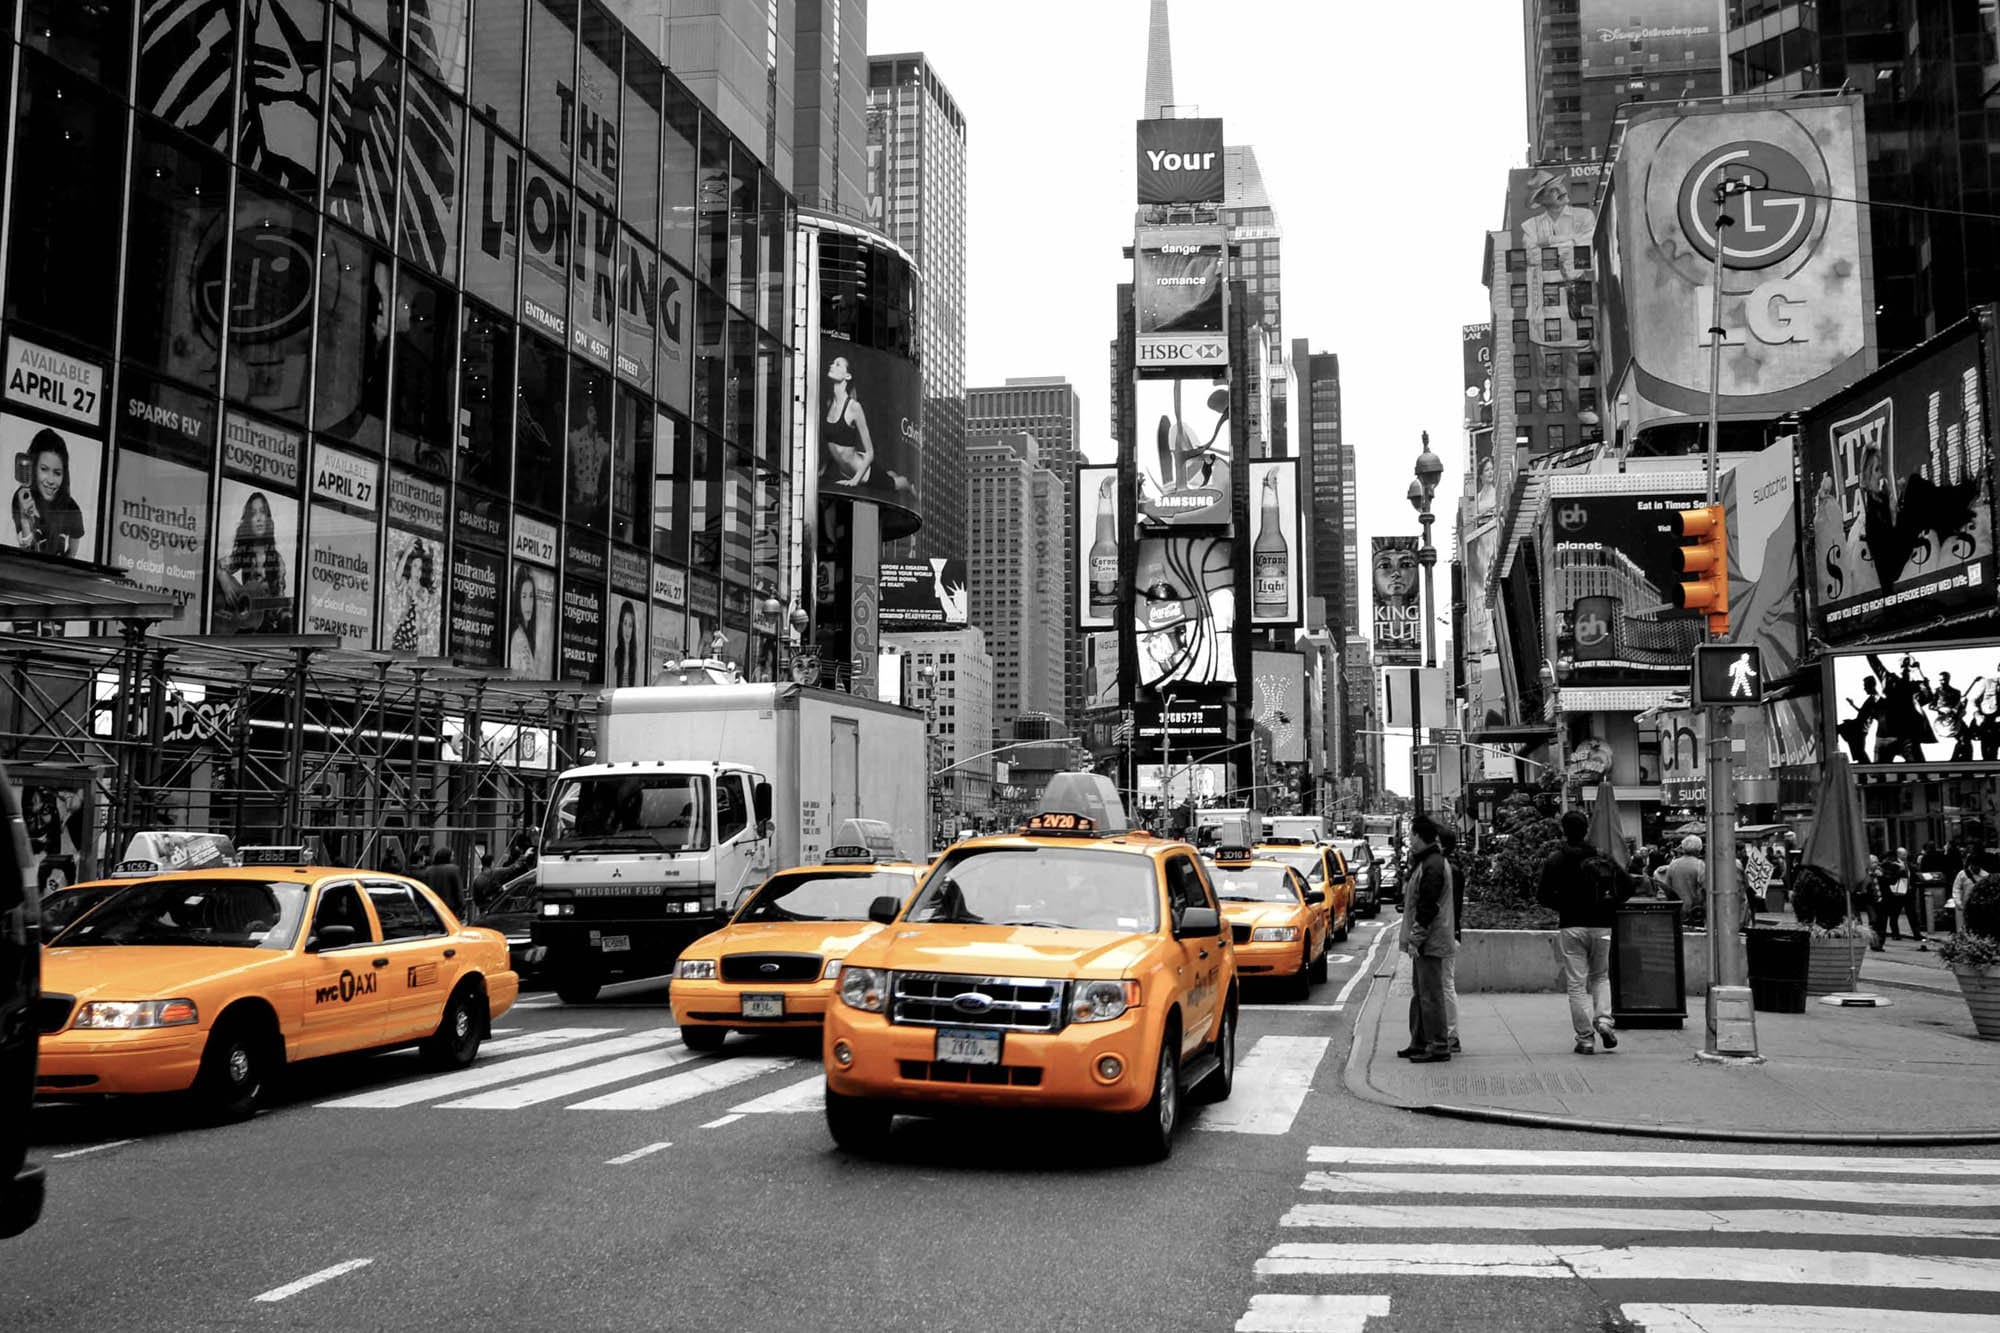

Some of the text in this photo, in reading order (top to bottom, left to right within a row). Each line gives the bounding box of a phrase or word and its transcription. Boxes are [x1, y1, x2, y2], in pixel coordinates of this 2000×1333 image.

[556, 79, 615, 181] THE
[1146, 150, 1216, 171] Your
[1571, 166, 1600, 177] 100%
[481, 104, 681, 345] LION KING
[1161, 243, 1201, 255] danger
[1156, 276, 1206, 285] romance
[1697, 279, 1808, 347] LG
[525, 300, 638, 377] ENTRANCE ON 45TH STREET
[1140, 344, 1193, 360] HSBC
[20, 348, 90, 385] AVAILABLE
[9, 368, 96, 414] APRIL 27
[128, 398, 201, 437] SPARKS FLY
[227, 420, 297, 460] miranda
[225, 443, 297, 480] cosgrove
[318, 470, 371, 502] APRIL 27
[391, 476, 442, 506] miranda
[122, 496, 197, 532] miranda
[389, 498, 443, 526] cosgrove
[1154, 496, 1214, 507] SAMSUNG
[1637, 501, 1652, 510] Eat
[1664, 500, 1691, 509] Times
[459, 510, 487, 531] SPARKS
[120, 520, 198, 551] cosgrove
[516, 536, 553, 560] APRIL 27
[1557, 541, 1602, 552] planet
[314, 545, 368, 574] miranda
[454, 559, 496, 584] miranda
[312, 566, 369, 592] cosgrove
[453, 577, 497, 600] cosgrove
[1852, 604, 1861, 616] GET
[1885, 594, 1897, 607] NEW
[1897, 588, 1920, 603] EPISODE
[1920, 583, 1938, 597] EVERY
[1938, 578, 1952, 592] WED
[1374, 605, 1419, 621] KING
[1375, 621, 1417, 639] TUT
[1042, 814, 1075, 829] 2V20
[126, 863, 147, 872] 1C55
[575, 887, 661, 896] MITSUBISHI FUSO
[316, 970, 377, 1004] NYC TAXI
